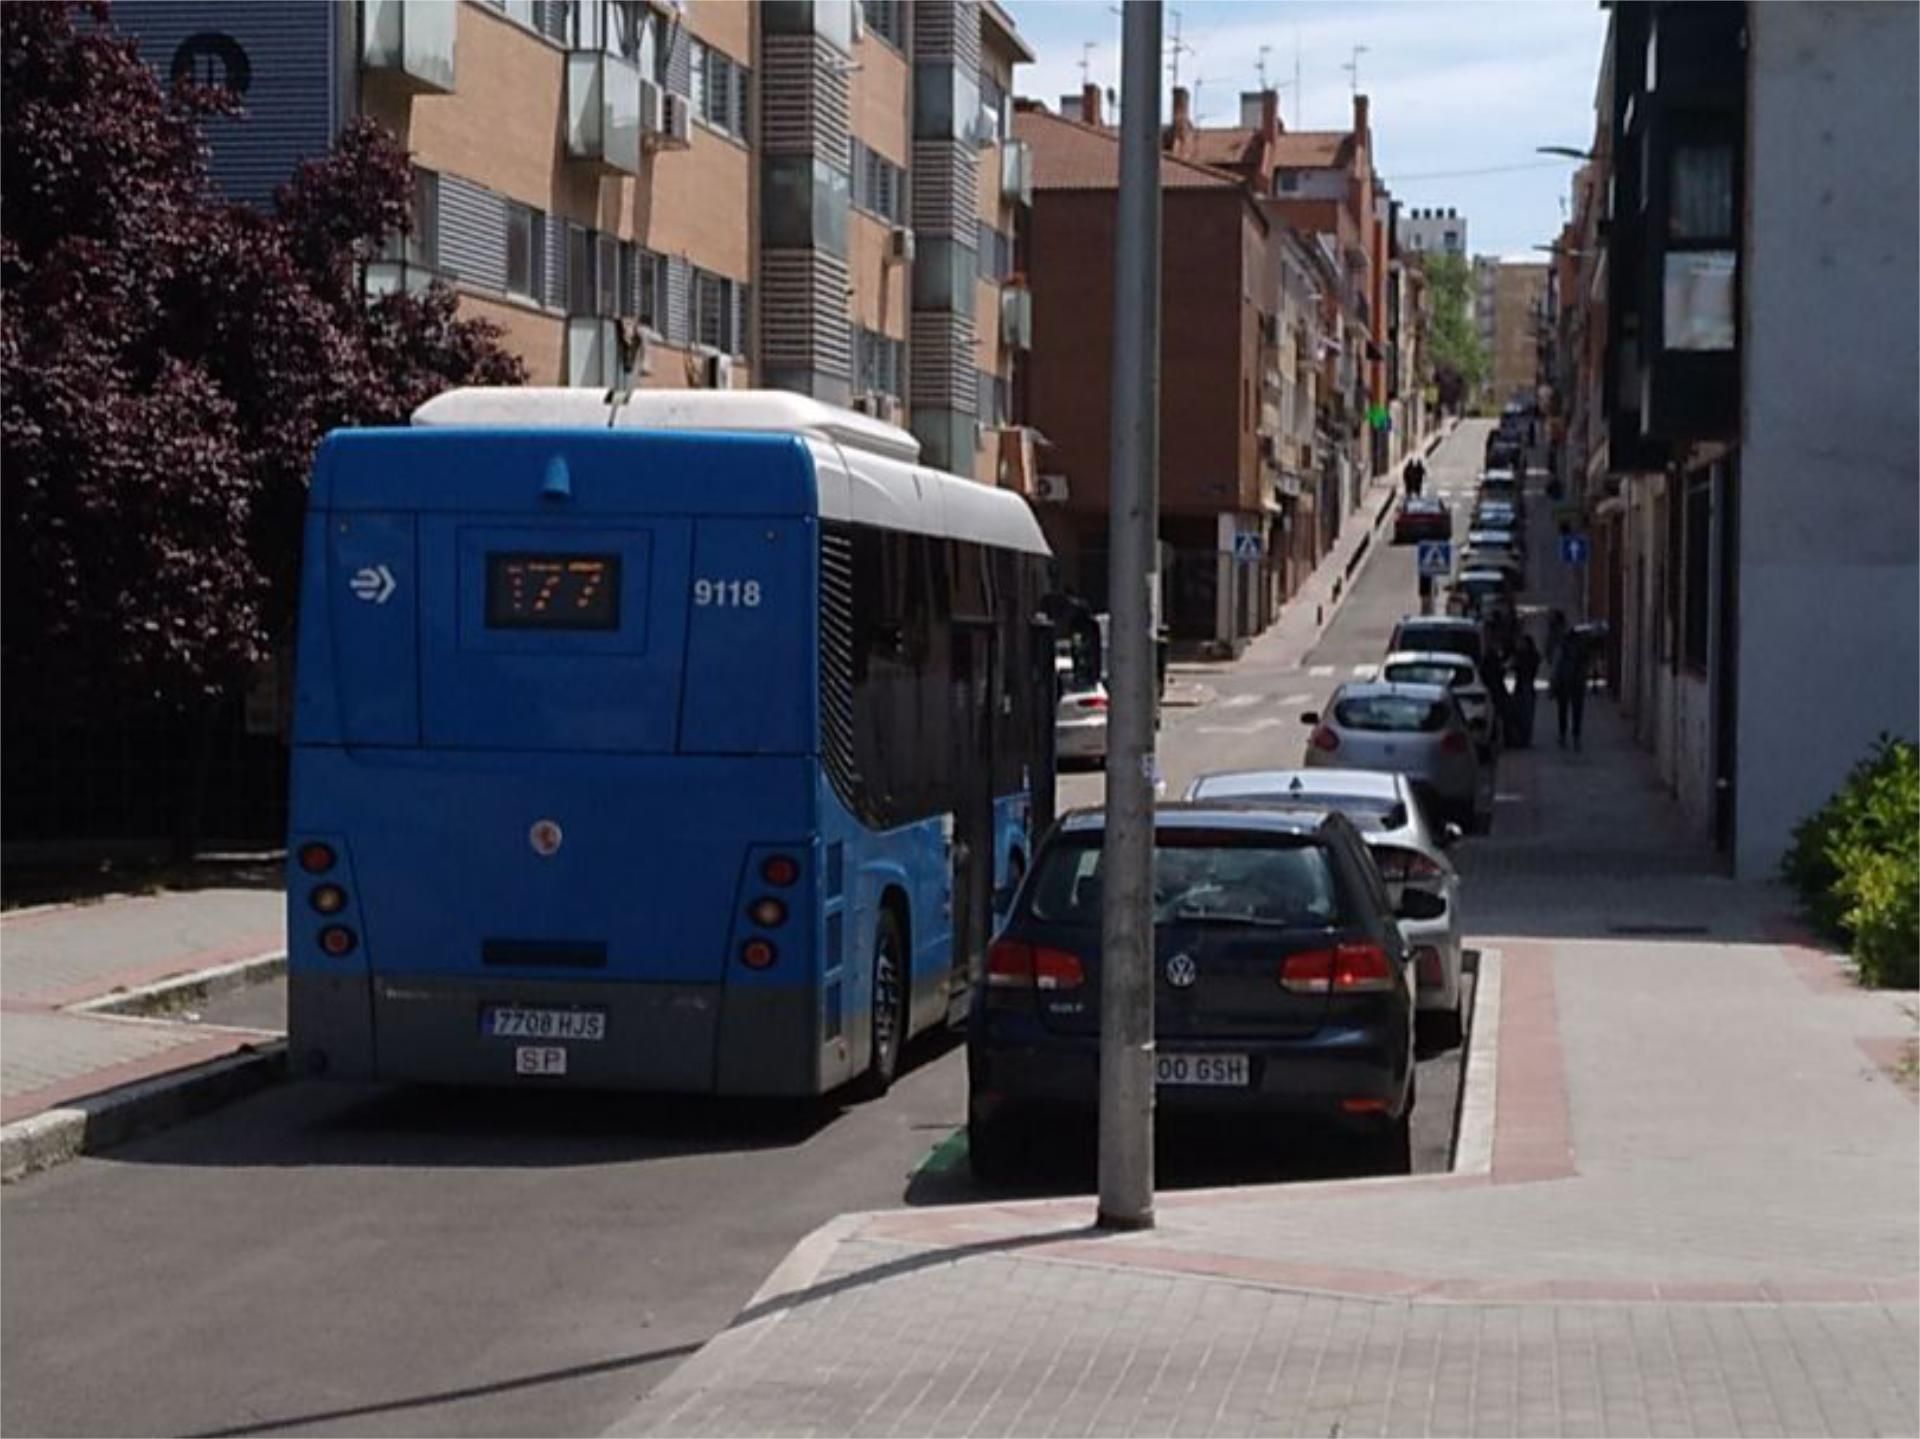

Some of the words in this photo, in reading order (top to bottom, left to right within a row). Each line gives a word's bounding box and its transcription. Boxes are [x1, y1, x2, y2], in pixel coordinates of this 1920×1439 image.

[507, 562, 603, 609] 177
[694, 579, 760, 607] 9118
[558, 1013, 600, 1035] HJS
[1157, 1058, 1188, 1080] 00
[1196, 1058, 1242, 1081] GSH
